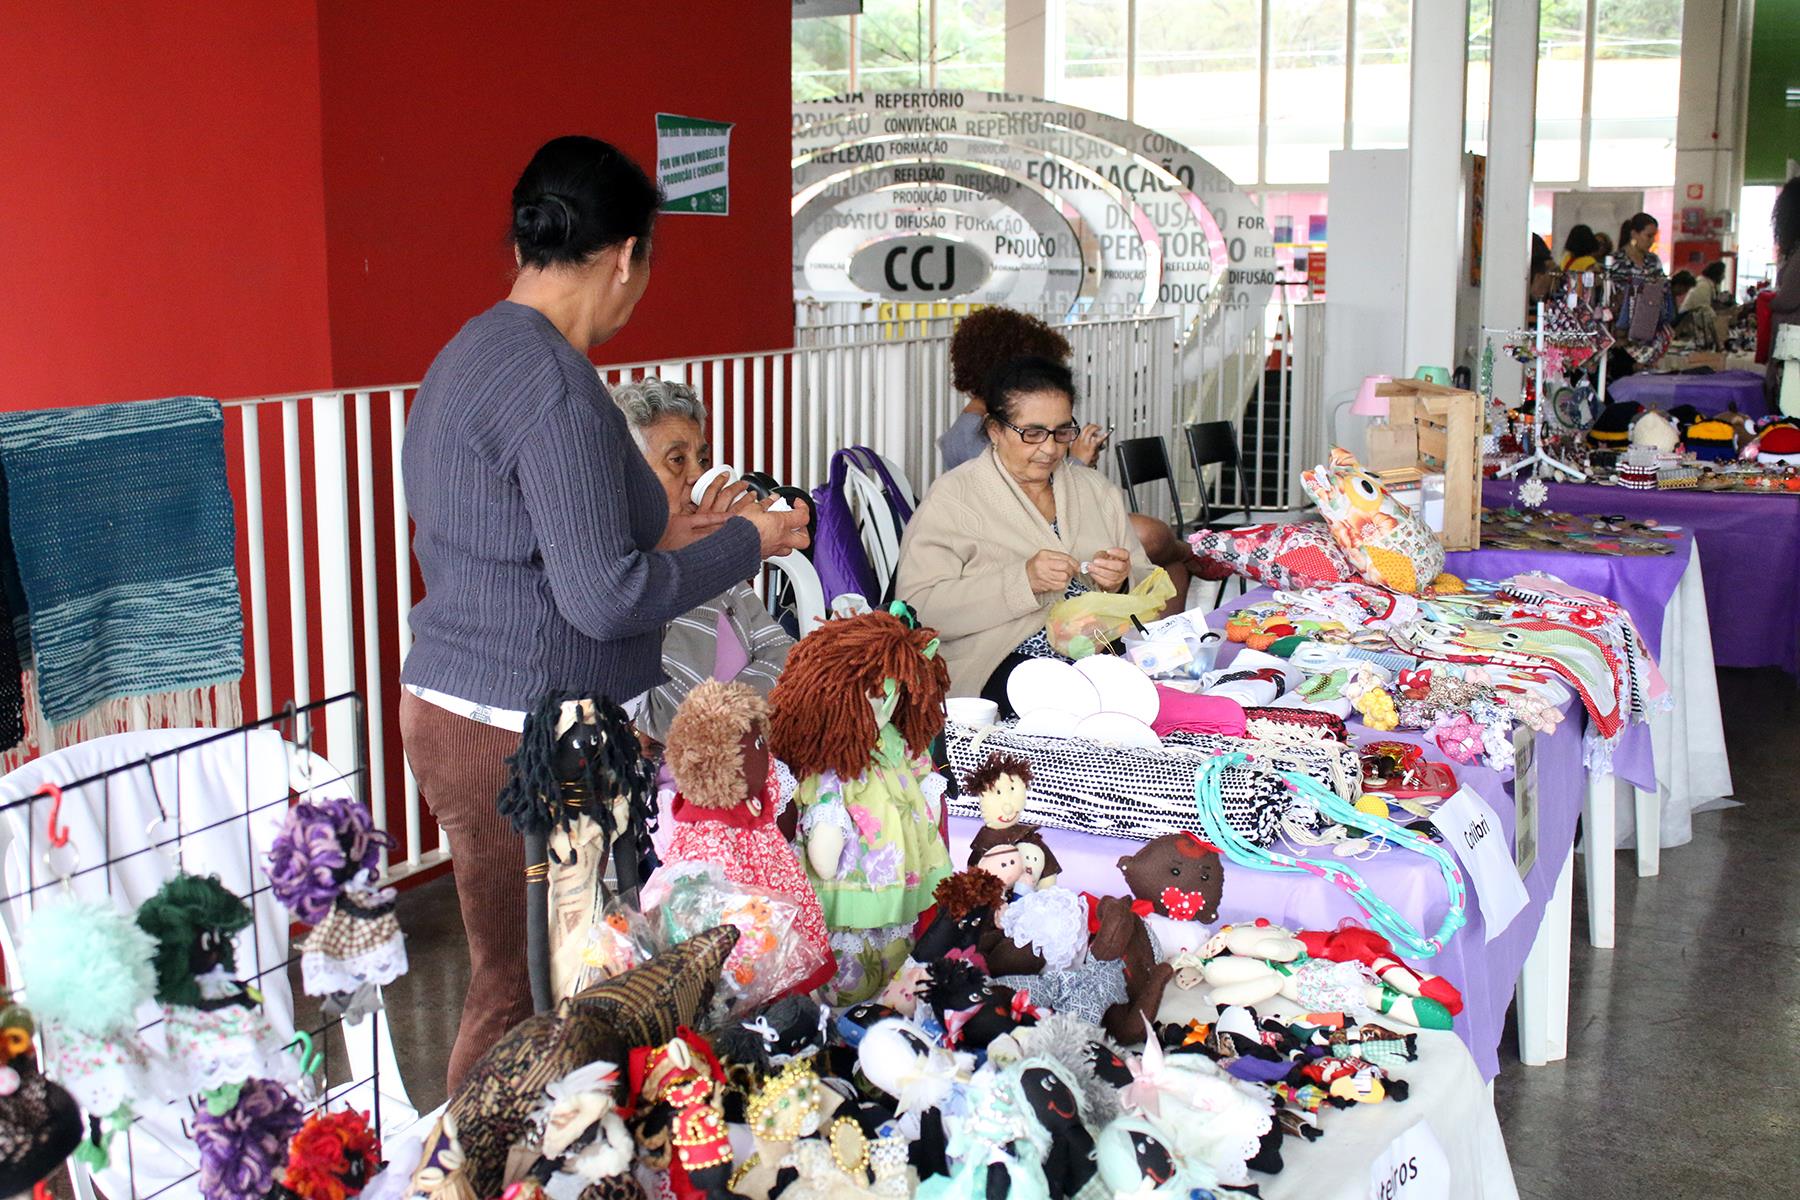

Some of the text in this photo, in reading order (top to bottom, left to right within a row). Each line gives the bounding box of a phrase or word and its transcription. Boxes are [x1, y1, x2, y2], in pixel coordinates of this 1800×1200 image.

[875, 90, 964, 109] REPERTÓRIO
[884, 115, 957, 134] CONVIVÊNCIA
[889, 139, 948, 158] FORMAÇÃO
[893, 164, 945, 182] REFLEXÃO
[1027, 157, 1195, 200] FORMAÇÃO
[893, 188, 947, 206] PRODUÇÃO
[895, 212, 946, 228] DIFUSÃO
[1238, 216, 1264, 229] FOR
[884, 245, 955, 292] CCJ
[1165, 260, 1210, 273] REFLEXÃO
[1229, 268, 1274, 285] DIFUSÃO
[1464, 813, 1491, 850] Colibri
[1376, 1156, 1418, 1200] teiros
